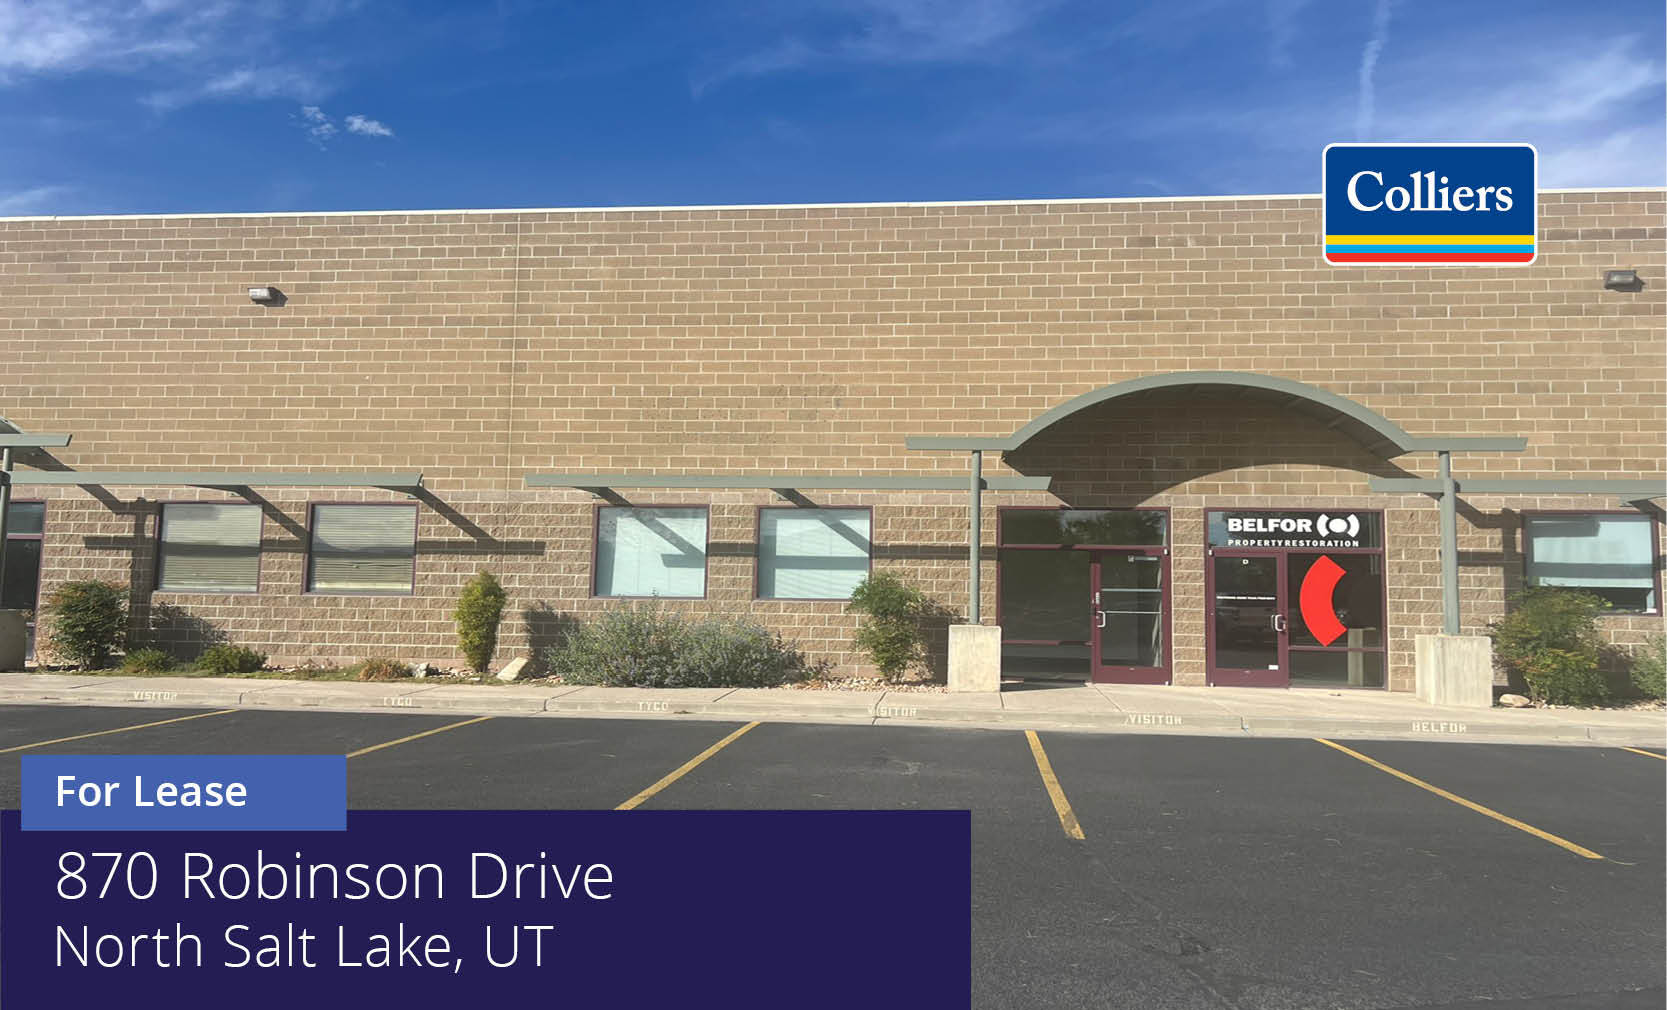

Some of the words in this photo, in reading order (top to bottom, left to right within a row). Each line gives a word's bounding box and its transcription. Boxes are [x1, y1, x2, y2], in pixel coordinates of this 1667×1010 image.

[1227, 518, 1313, 533] BELFOR
[1128, 714, 1182, 725] VISITOR
[1411, 721, 1467, 733] BELFOR
